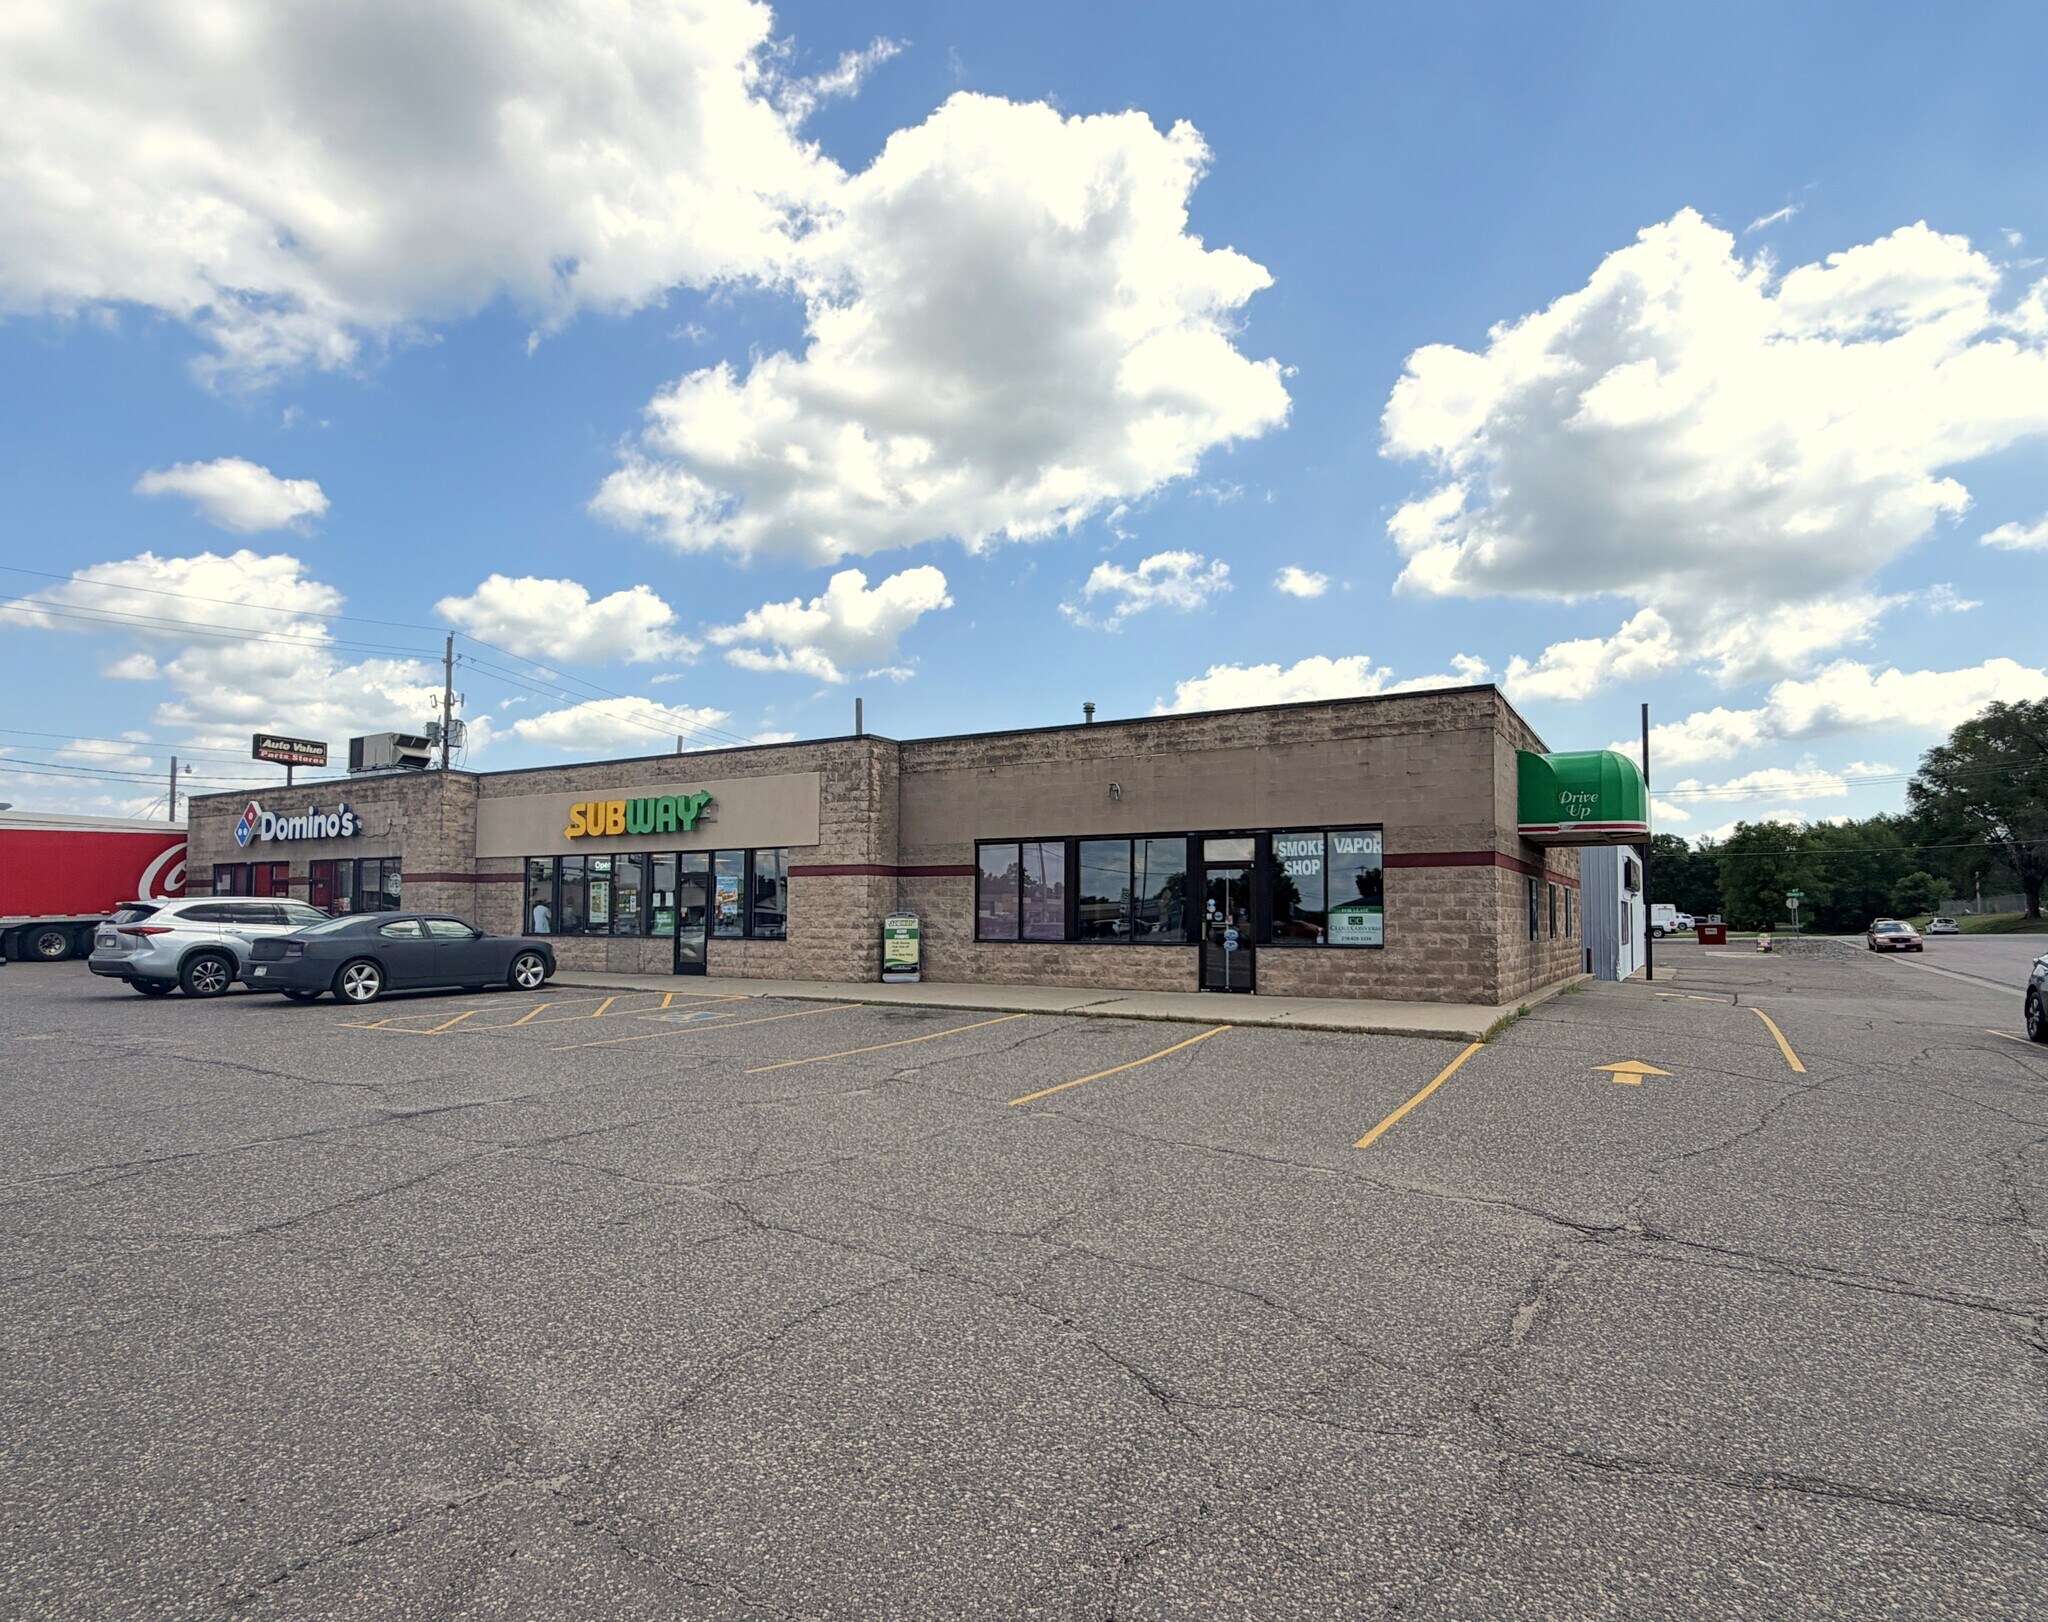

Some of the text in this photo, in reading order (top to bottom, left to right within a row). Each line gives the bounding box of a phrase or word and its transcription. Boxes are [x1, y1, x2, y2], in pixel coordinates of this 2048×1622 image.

[262, 739, 323, 755] Auto Value
[261, 751, 325, 765] Parts Stores
[1558, 790, 1599, 805] Drive
[564, 789, 713, 840] SUBWAY
[1566, 804, 1591, 820] Up
[261, 803, 356, 841] Domino's
[1278, 839, 1324, 858] SMOKE
[1333, 836, 1382, 854] VAPOR
[1284, 858, 1321, 876] SHOP
